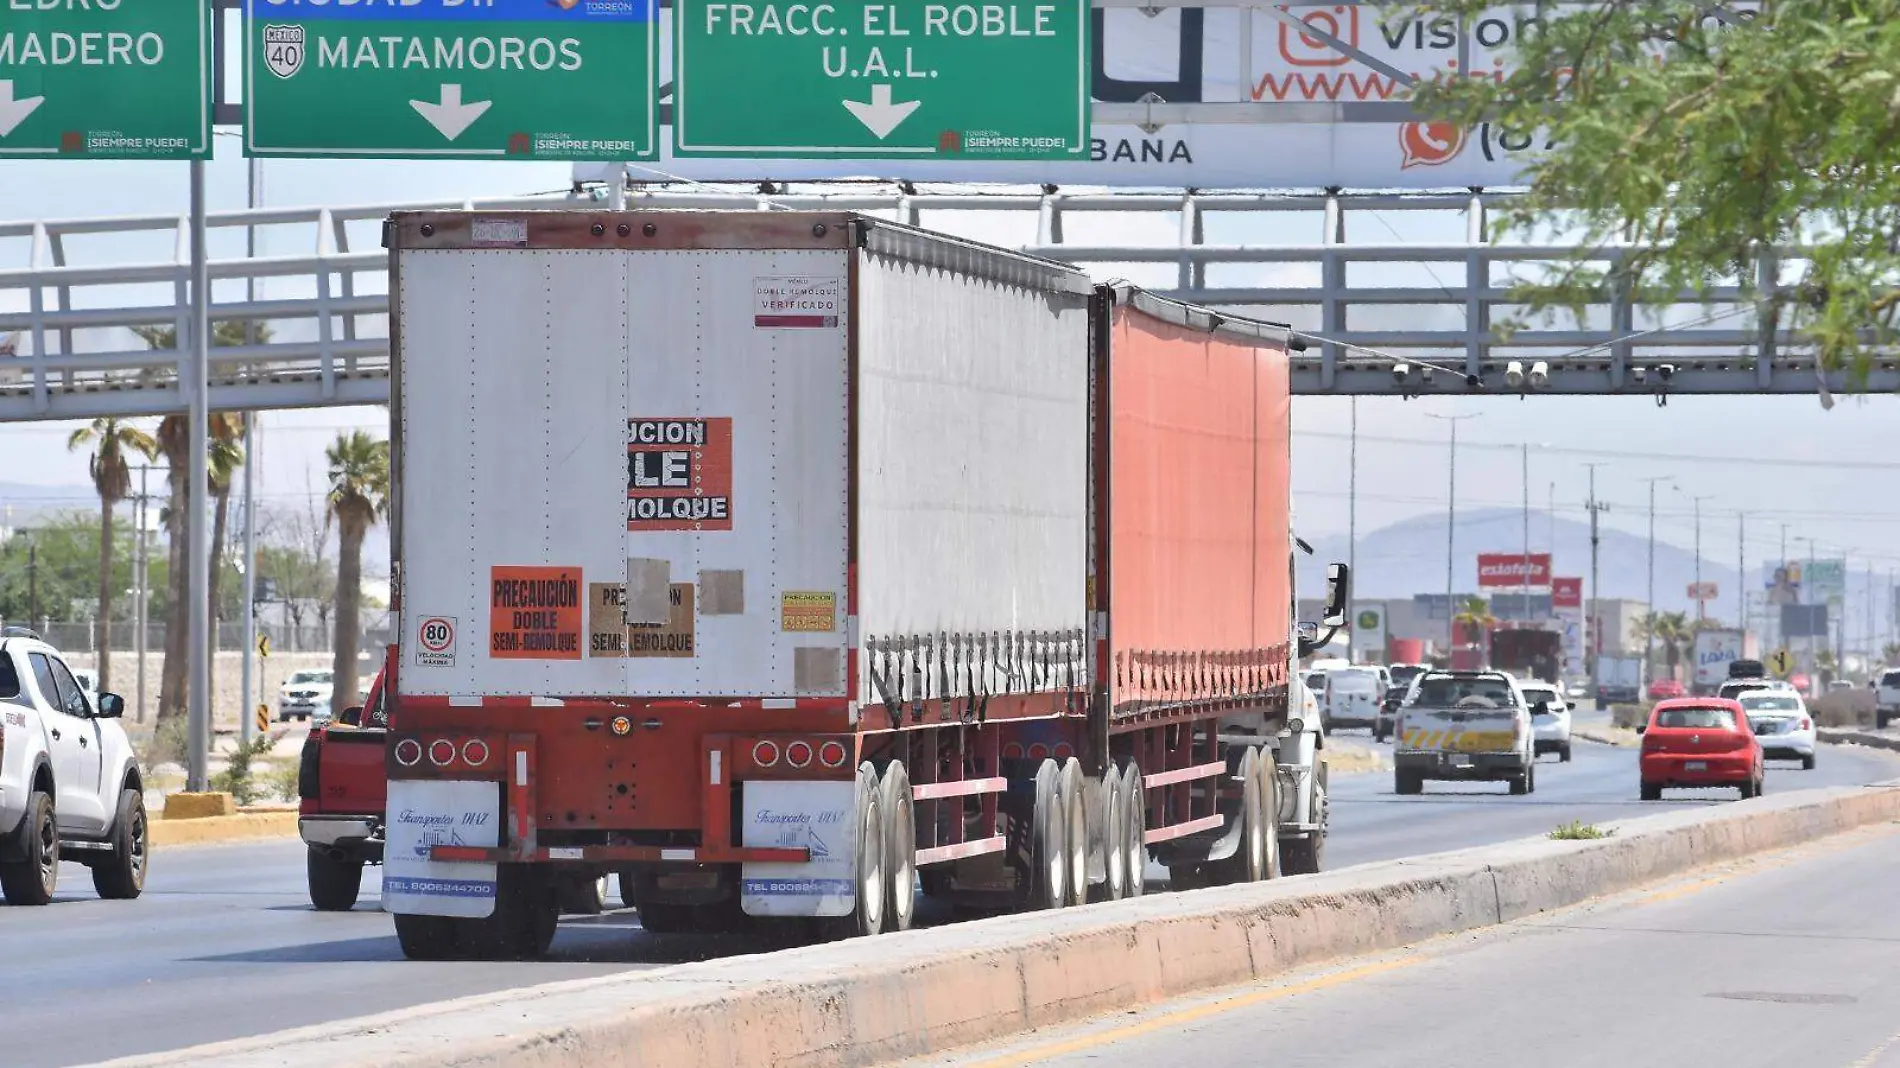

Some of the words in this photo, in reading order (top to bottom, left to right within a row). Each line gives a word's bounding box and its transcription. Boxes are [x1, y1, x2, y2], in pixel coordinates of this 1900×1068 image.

[706, 4, 847, 36] FRACC.
[864, 5, 910, 36] EL
[925, 5, 1056, 36] ROBLE
[271, 46, 297, 66] 40
[318, 36, 582, 71] MATAMOROS
[822, 46, 938, 78] U.A.L.
[145, 138, 188, 148] PUEDE!
[592, 141, 635, 151] PUEDE!
[1023, 138, 1066, 148] PUEDE!
[761, 300, 834, 310] VERIFICADO
[493, 573, 578, 607] PRECAUCIÓN
[513, 611, 558, 630] DOBLE
[426, 625, 448, 640] 80
[493, 632, 577, 652] SEMI-REMOLQUE
[747, 884, 768, 892] TEL
